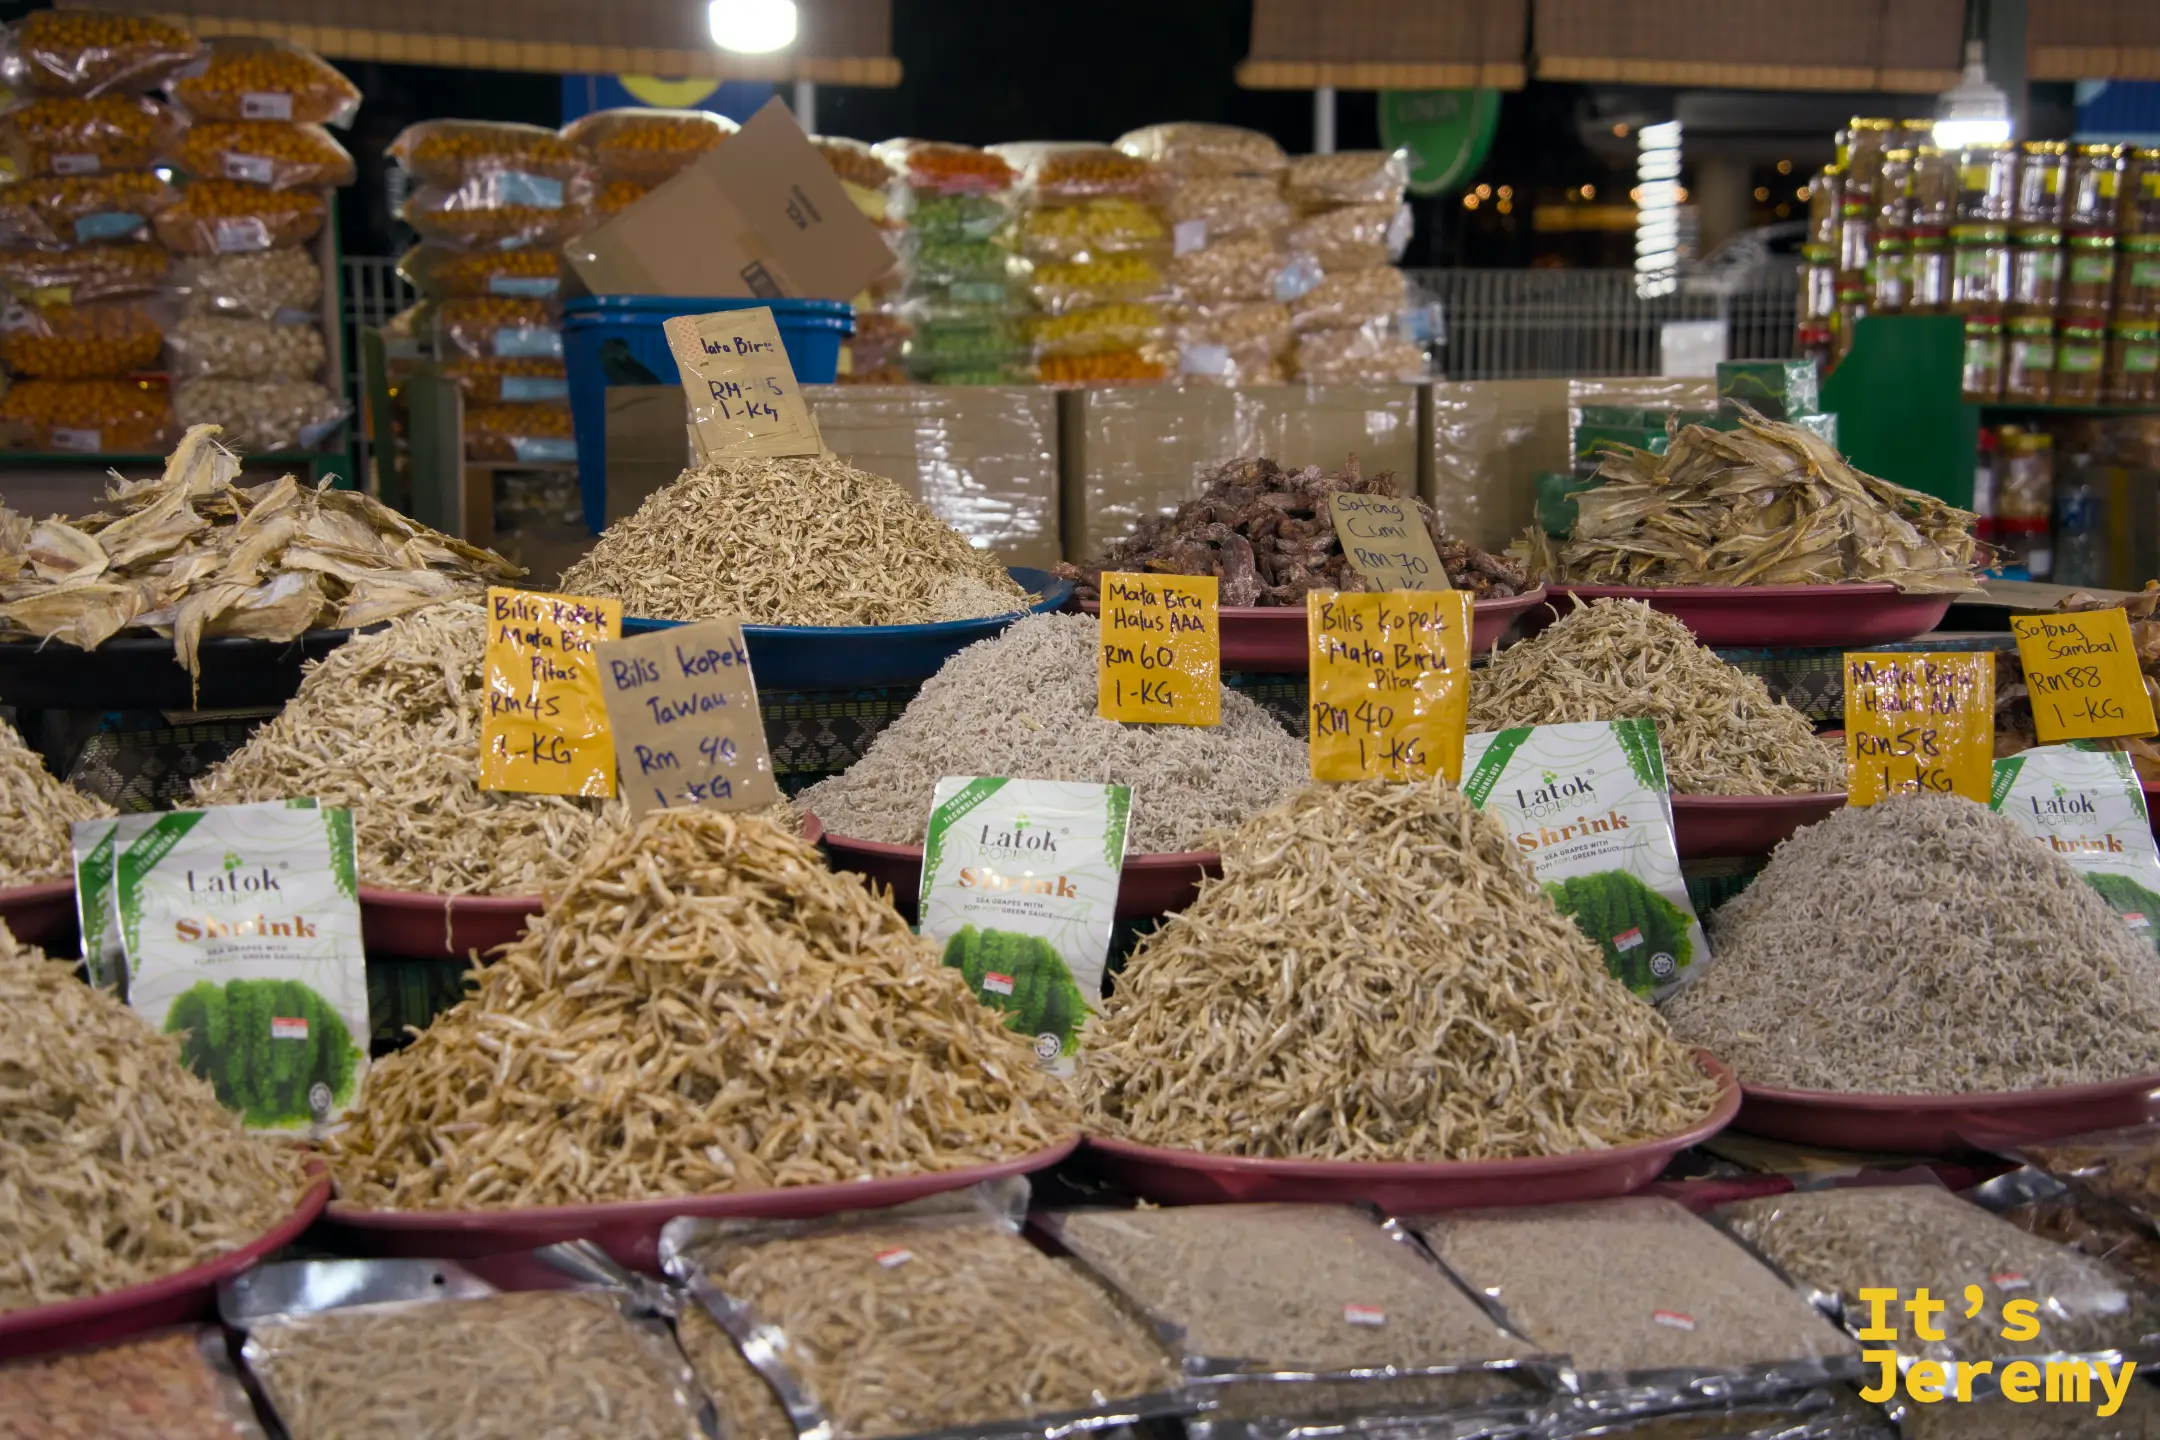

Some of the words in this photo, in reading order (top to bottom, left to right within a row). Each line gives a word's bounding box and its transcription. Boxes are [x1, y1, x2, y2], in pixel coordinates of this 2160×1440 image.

[495, 596, 539, 621] Bilis
[1109, 582, 1158, 606] Mata
[1163, 588, 1202, 610] Biru
[1114, 607, 1164, 632] Halus
[1170, 612, 1206, 633] AAA
[1320, 602, 1363, 632] Bilis
[2014, 618, 2085, 641] Sotong
[500, 625, 553, 649] Mata
[561, 630, 596, 654] Bir
[2047, 632, 2119, 660] Sambal
[1330, 639, 1384, 668] Mata
[1393, 643, 1446, 670] Biru
[531, 656, 577, 682] Pitas
[610, 658, 660, 690] Bilis
[1852, 660, 1916, 690] Mata
[1925, 663, 1970, 687] Biru
[1468, 767, 1487, 790] SHRINK
[1473, 762, 1501, 801] TECHNOLOGY
[1516, 774, 1594, 809] Latok
[2031, 793, 2096, 814] Latok
[980, 824, 1057, 852] Latok
[1516, 810, 1630, 853] Shrink
[2035, 834, 2125, 853] hrink
[1544, 852, 1558, 861] SEA
[1559, 844, 1589, 856] GRAPES
[1589, 839, 1609, 850] WITH
[1572, 851, 1597, 861] GREEN
[1597, 845, 1621, 855] SAUCE
[187, 865, 280, 892] Latok
[958, 867, 1078, 899] Shrink
[1023, 901, 1043, 909] WITH
[175, 913, 317, 943] Shrink
